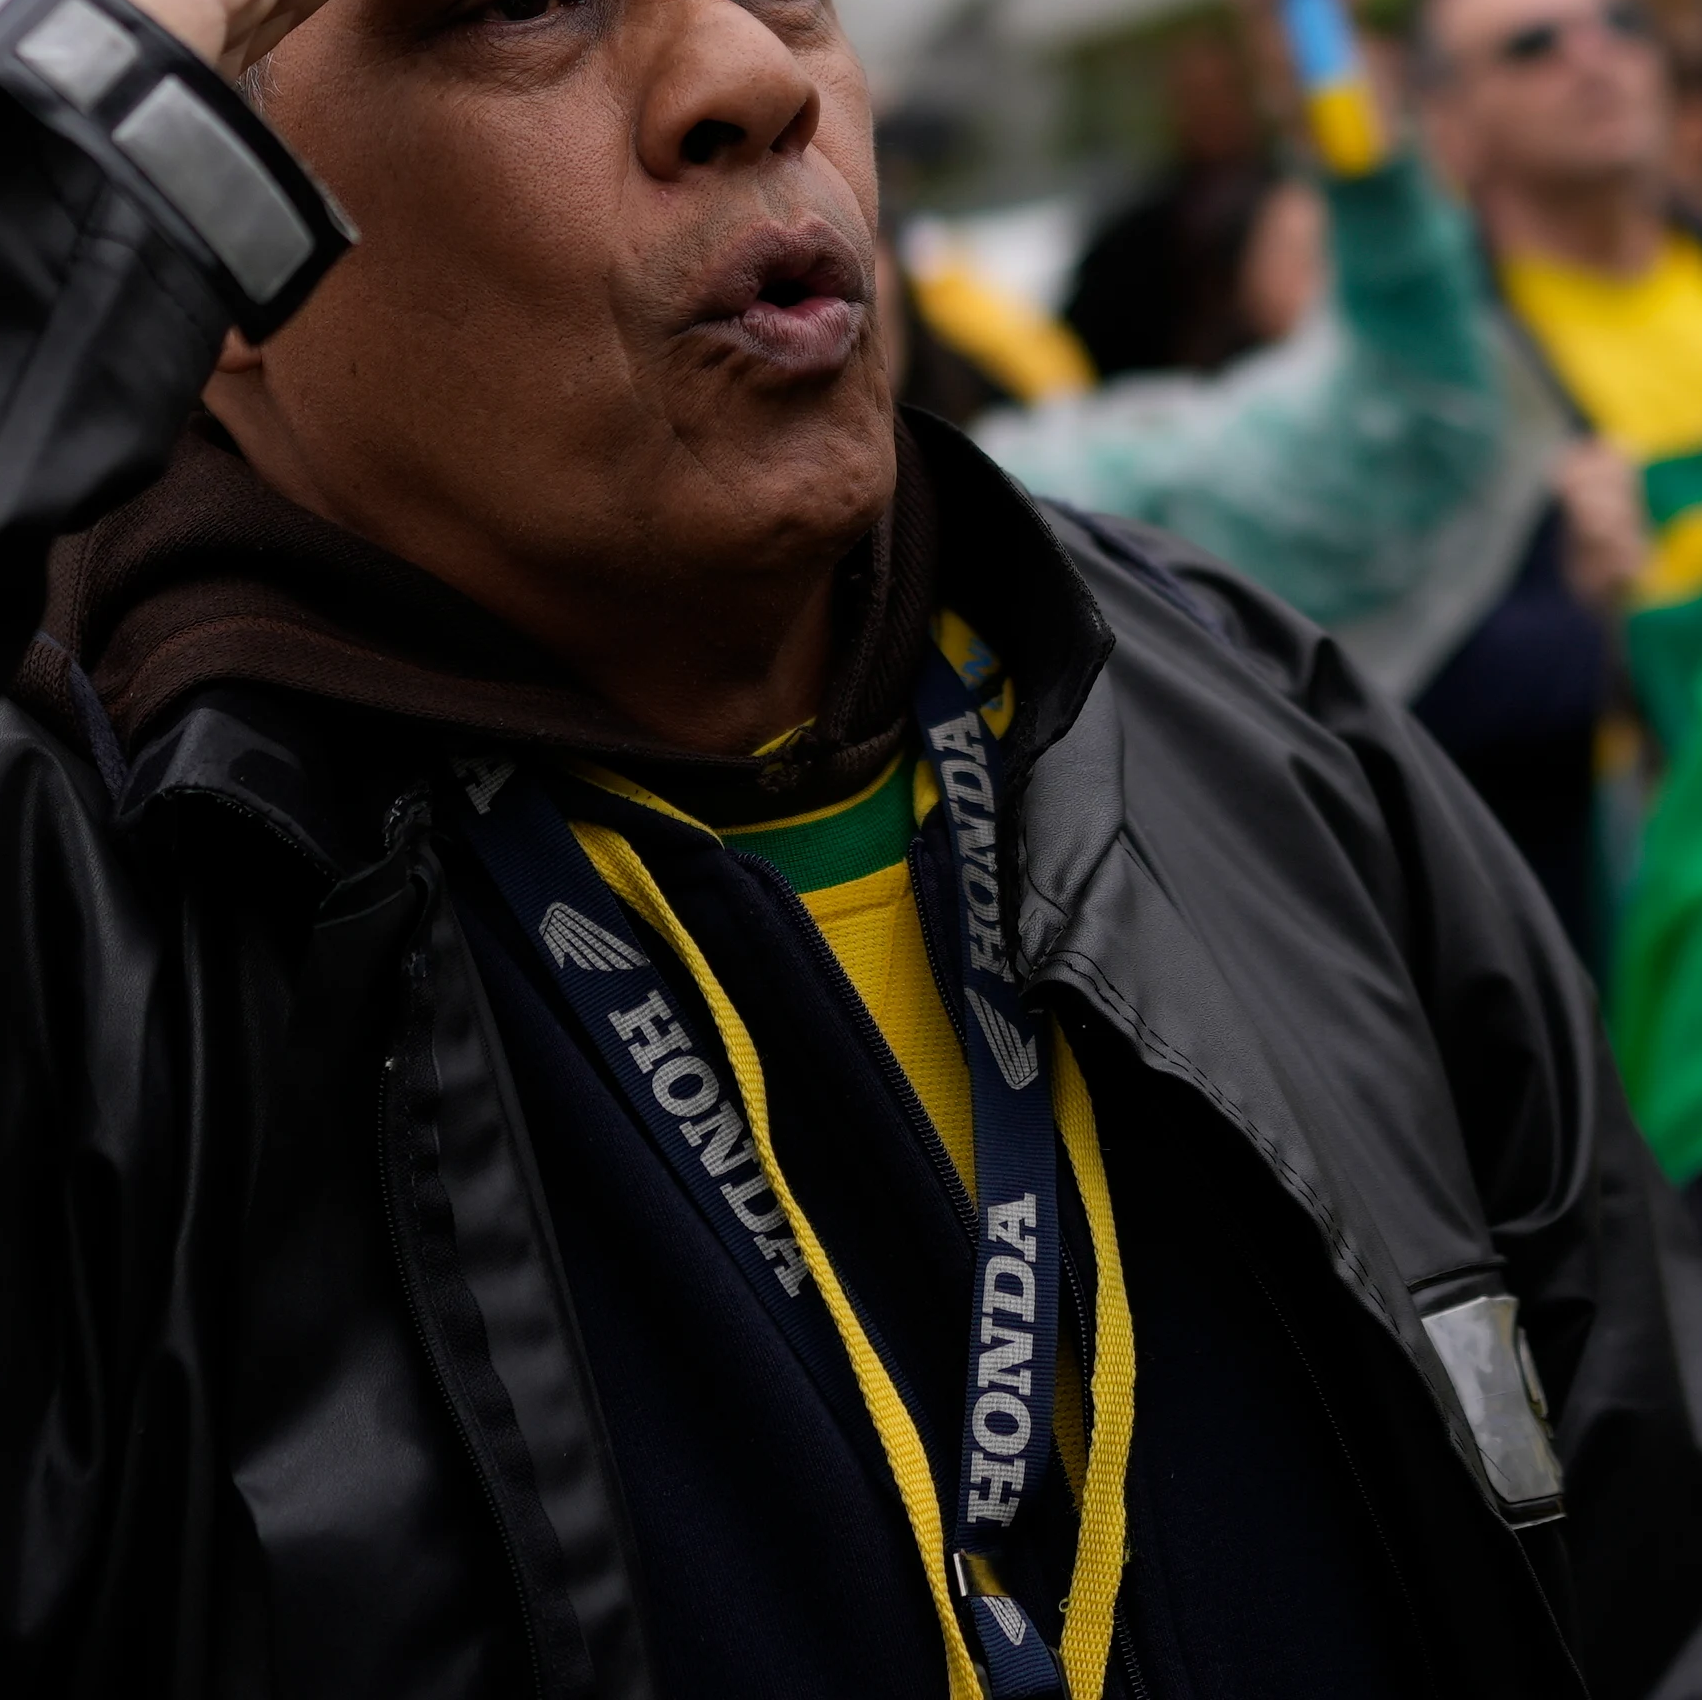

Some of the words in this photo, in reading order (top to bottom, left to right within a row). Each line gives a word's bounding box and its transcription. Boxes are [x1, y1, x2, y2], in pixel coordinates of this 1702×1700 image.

[928, 710, 1016, 982] HONDA
[608, 990, 808, 1298] HONDA
[967, 1193, 1038, 1527] HONDA
